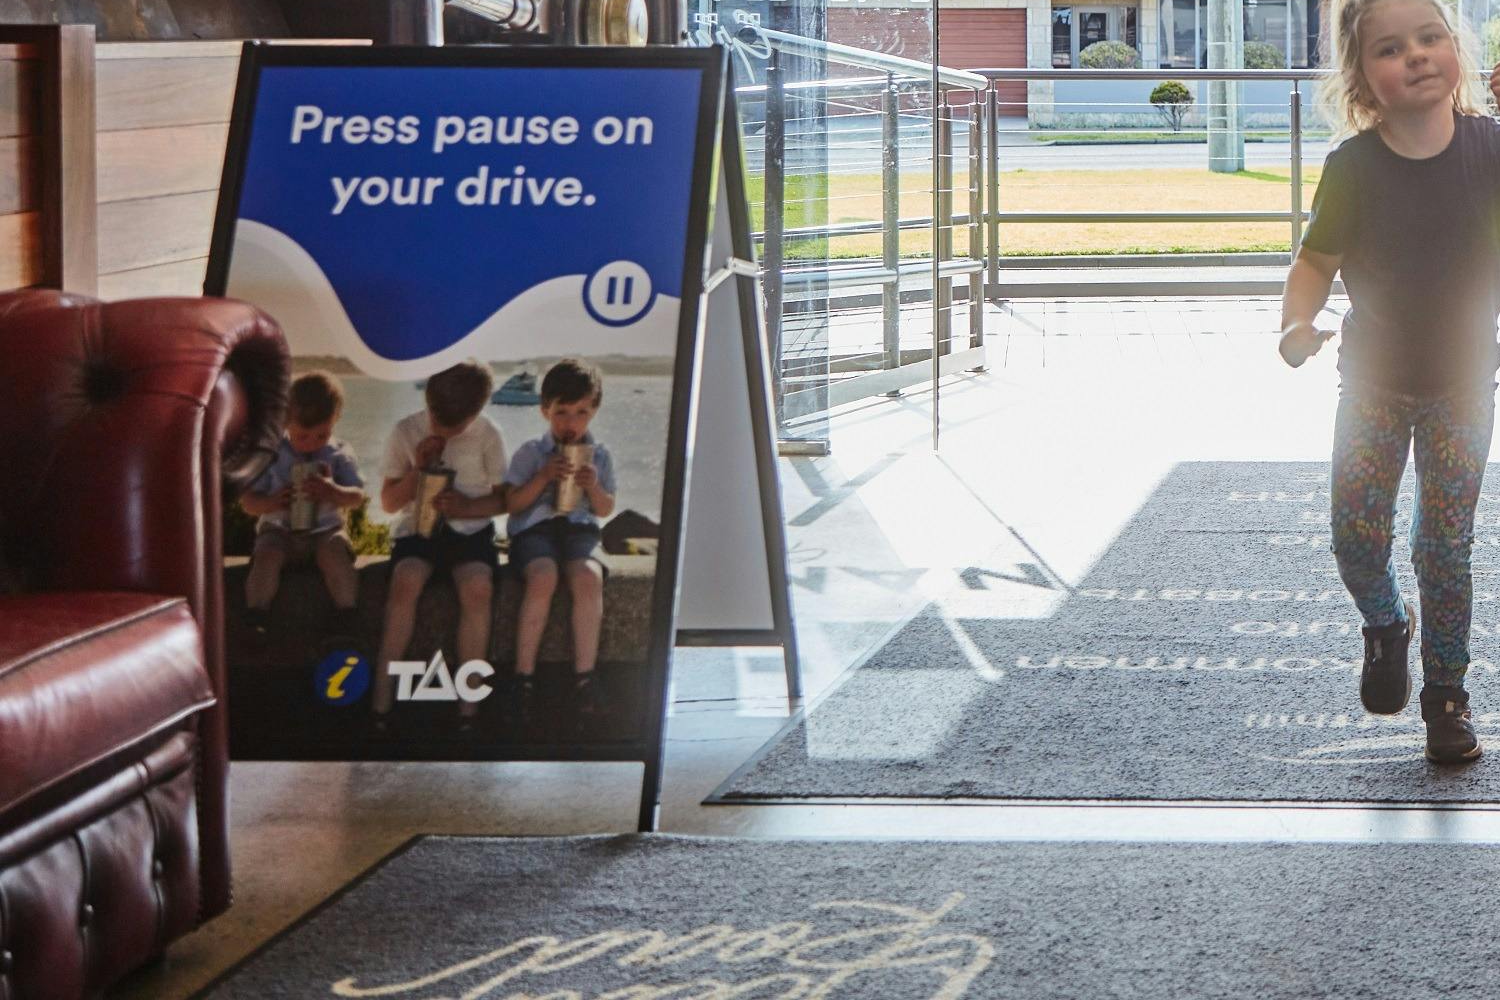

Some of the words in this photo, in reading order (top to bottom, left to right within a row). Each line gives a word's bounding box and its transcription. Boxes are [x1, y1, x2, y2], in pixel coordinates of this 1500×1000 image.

[290, 105, 420, 144] Press
[432, 115, 580, 153] pause
[592, 115, 654, 145] on
[330, 175, 444, 215] your
[455, 165, 597, 206] drive.
[387, 649, 496, 703] TAC
